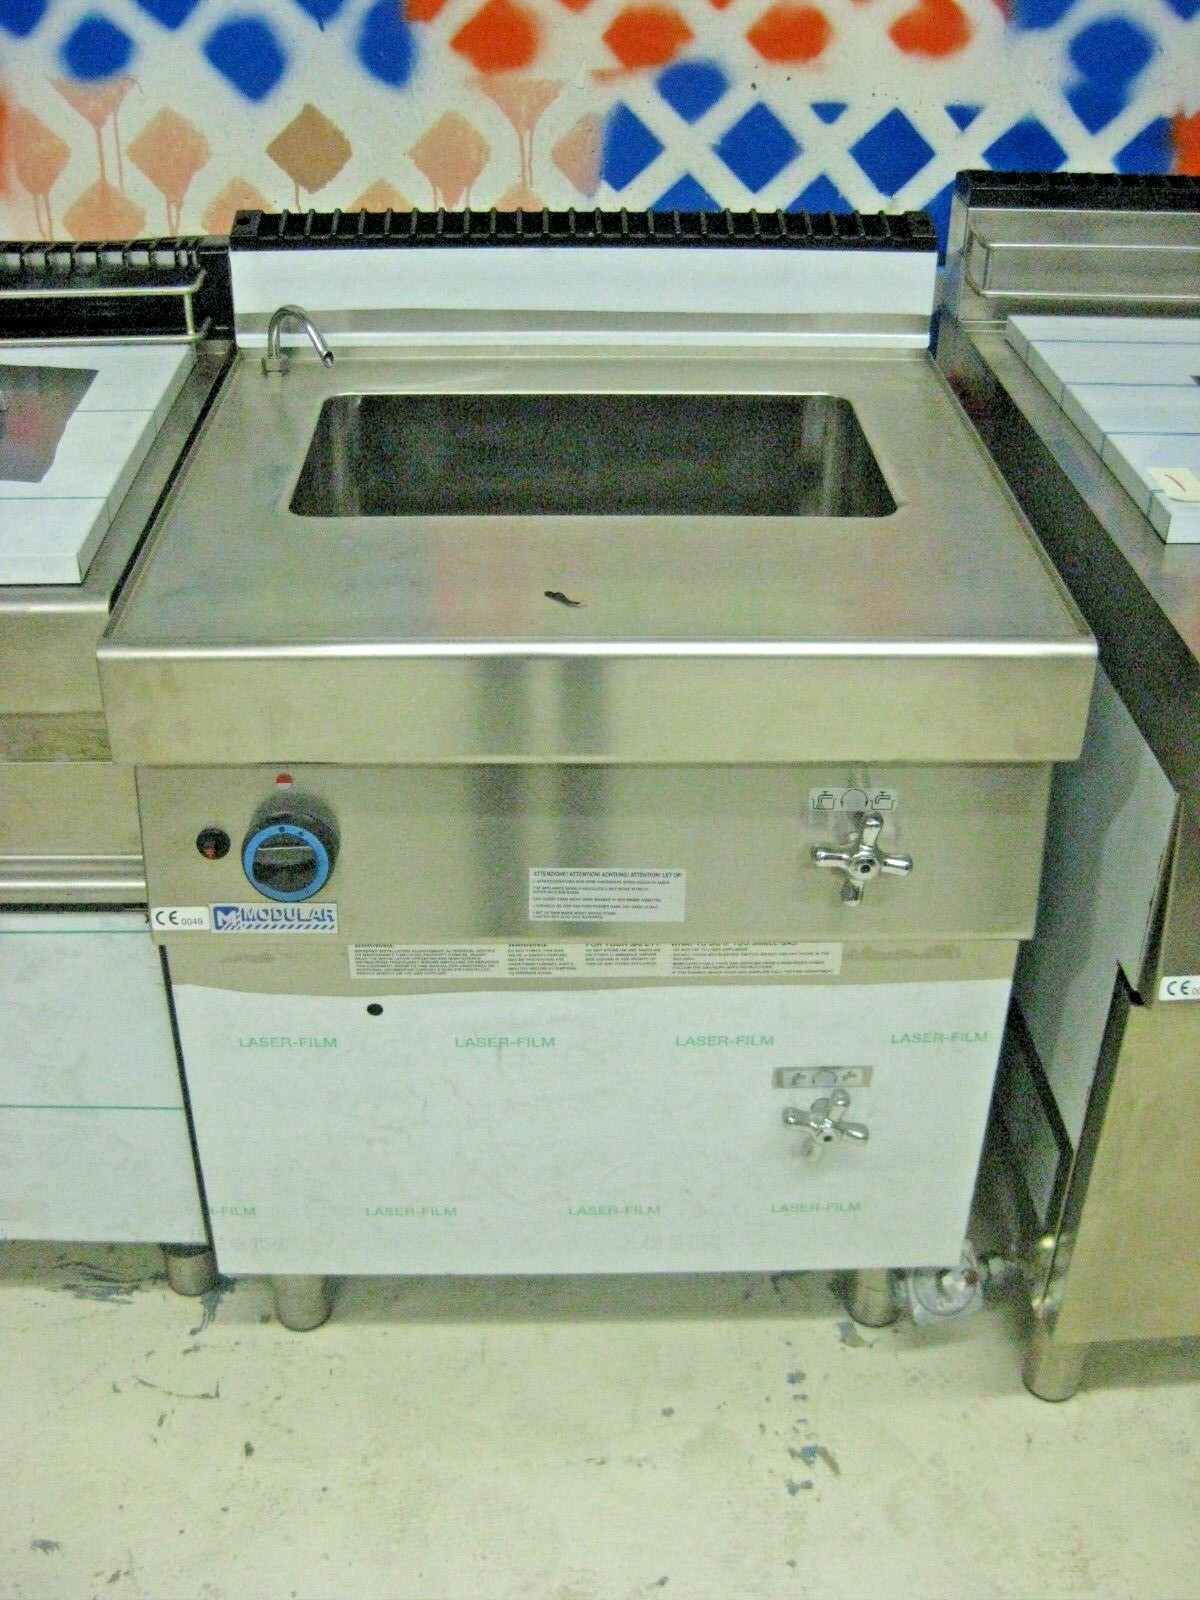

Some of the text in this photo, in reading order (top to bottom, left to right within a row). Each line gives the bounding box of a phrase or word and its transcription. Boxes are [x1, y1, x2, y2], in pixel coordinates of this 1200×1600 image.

[240, 907, 335, 923] MODULAR
[181, 917, 204, 926] 0049
[238, 1036, 338, 1048] LASER-FILM
[455, 1036, 556, 1048] LASER-FILM
[675, 1035, 775, 1047] LASER-FILM
[891, 1031, 989, 1044] LASER-FILM
[365, 1206, 457, 1217] LASER-FILM
[567, 1205, 661, 1217] LASER-FILM
[771, 1202, 862, 1214] LASER-FILM
